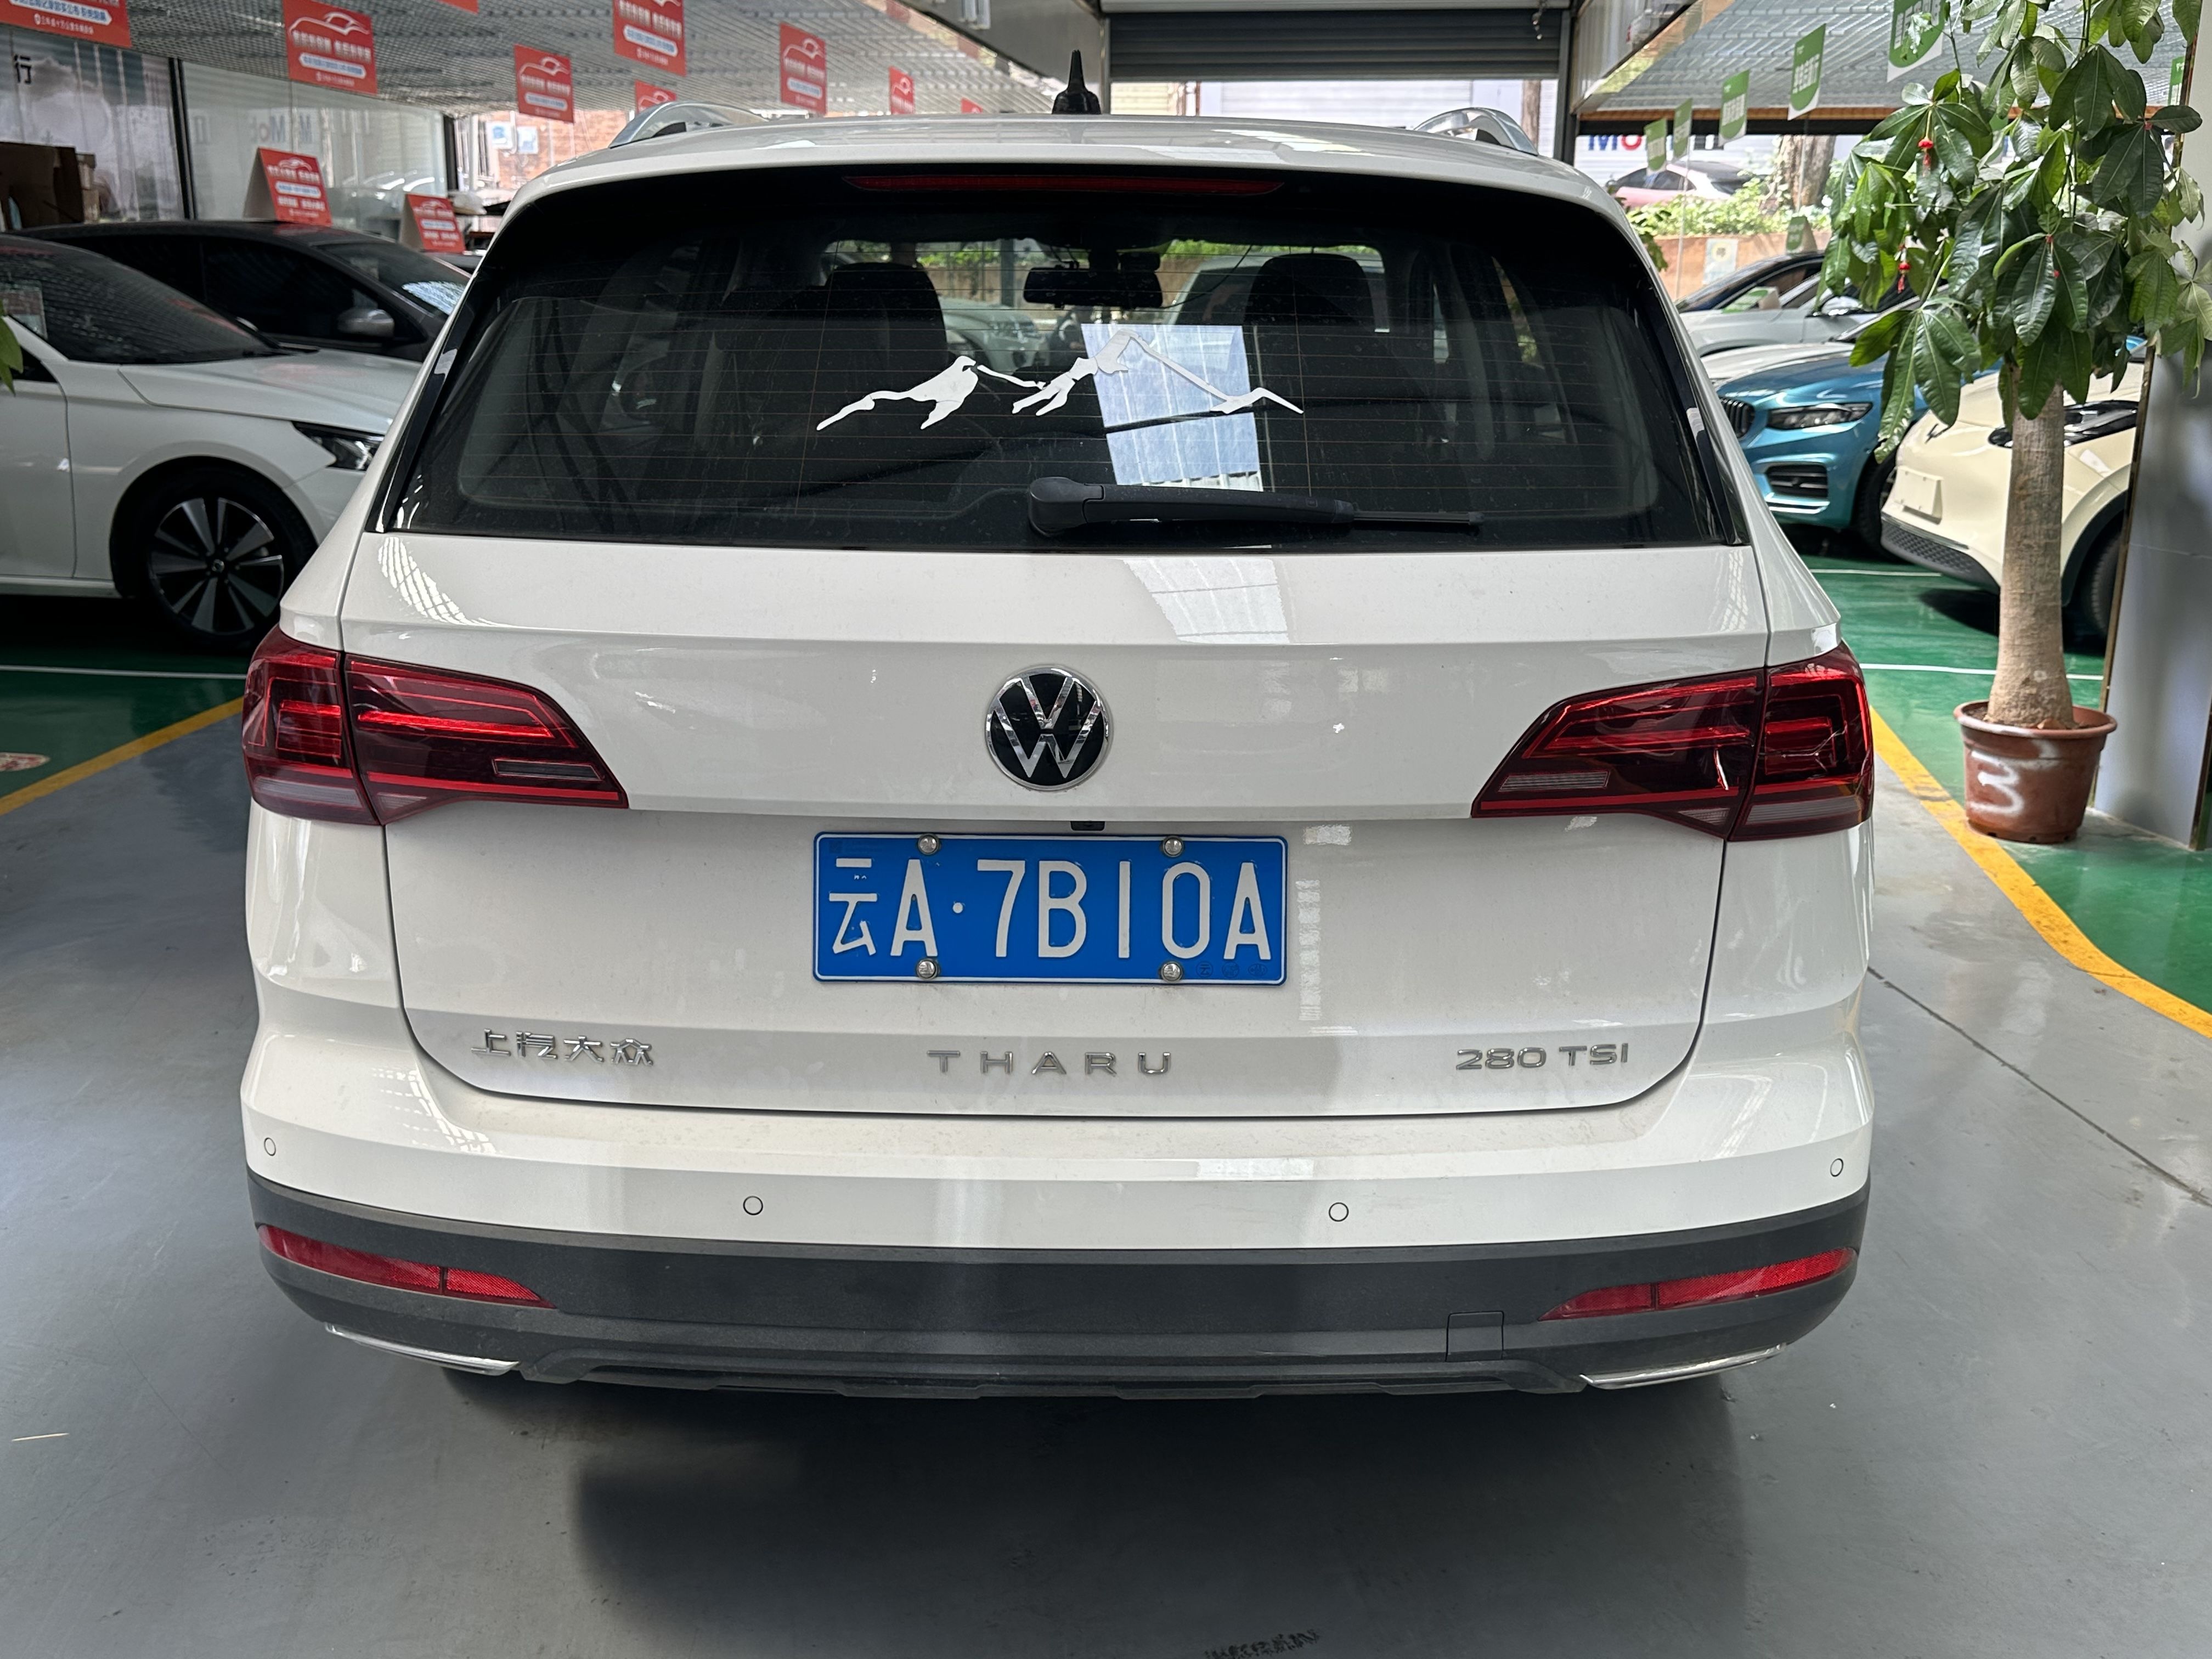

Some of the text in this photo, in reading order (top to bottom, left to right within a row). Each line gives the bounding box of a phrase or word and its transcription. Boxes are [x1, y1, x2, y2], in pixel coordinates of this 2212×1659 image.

[471, 1029, 653, 1065] 上汽大众
[1456, 1043, 1628, 1070] 280 TSI
[927, 1050, 1171, 1076] THARU
